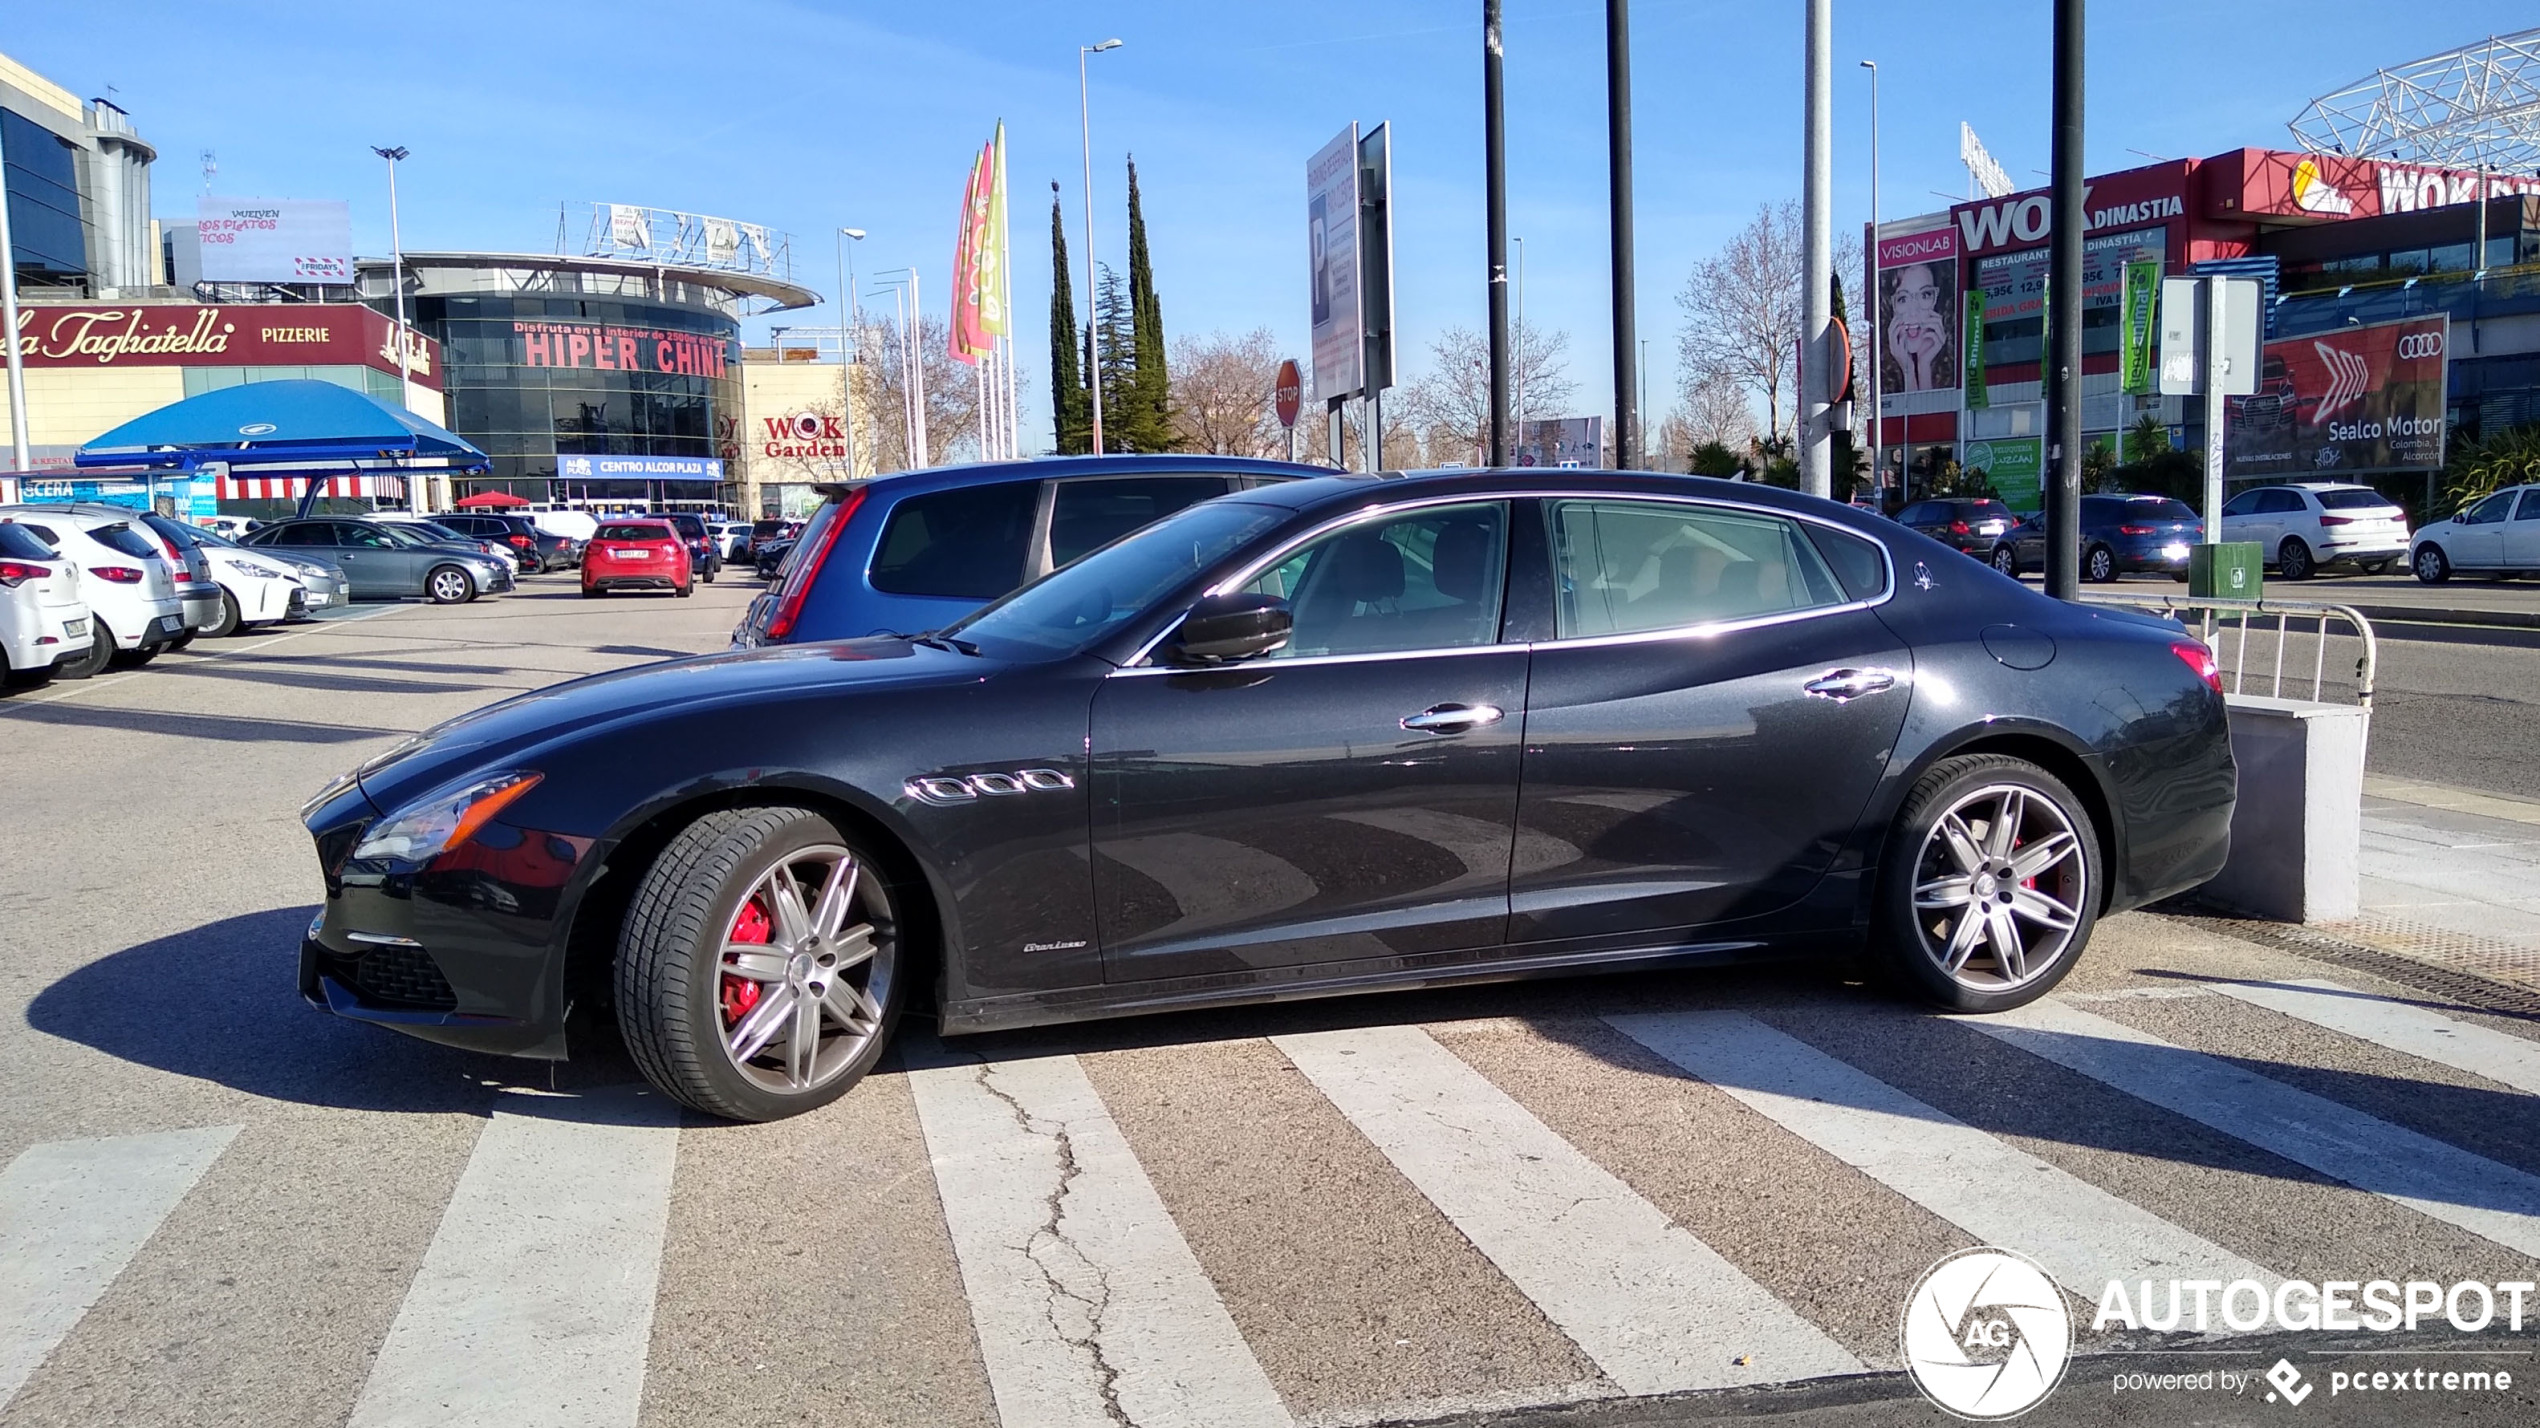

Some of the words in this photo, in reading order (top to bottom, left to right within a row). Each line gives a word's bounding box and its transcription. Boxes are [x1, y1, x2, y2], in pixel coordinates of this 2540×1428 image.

[231, 209, 280, 219] VUELVEN
[2094, 195, 2184, 229] DINASTIA
[222, 218, 277, 232] PLATOS
[1881, 236, 1950, 260] VISIONLAB
[305, 263, 338, 271] FRIDAYS
[42, 309, 236, 363] Tagliatella
[261, 327, 330, 343] PIZZERIE
[514, 322, 571, 334] Disfruta
[574, 327, 591, 335] en
[606, 329, 649, 339] interior
[651, 331, 665, 340] de
[524, 332, 640, 371] HIPER
[656, 340, 727, 379] CHINA
[1277, 386, 1298, 403] STOP
[2328, 421, 2382, 441] Sealco
[2386, 416, 2441, 437] Motor
[765, 441, 846, 457] Garden
[2390, 439, 2432, 450] Colombia,
[2402, 450, 2441, 462] Alcorcón
[600, 461, 643, 473] CENTRO
[645, 462, 675, 473] ALCOR
[677, 463, 702, 474] PLAZA
